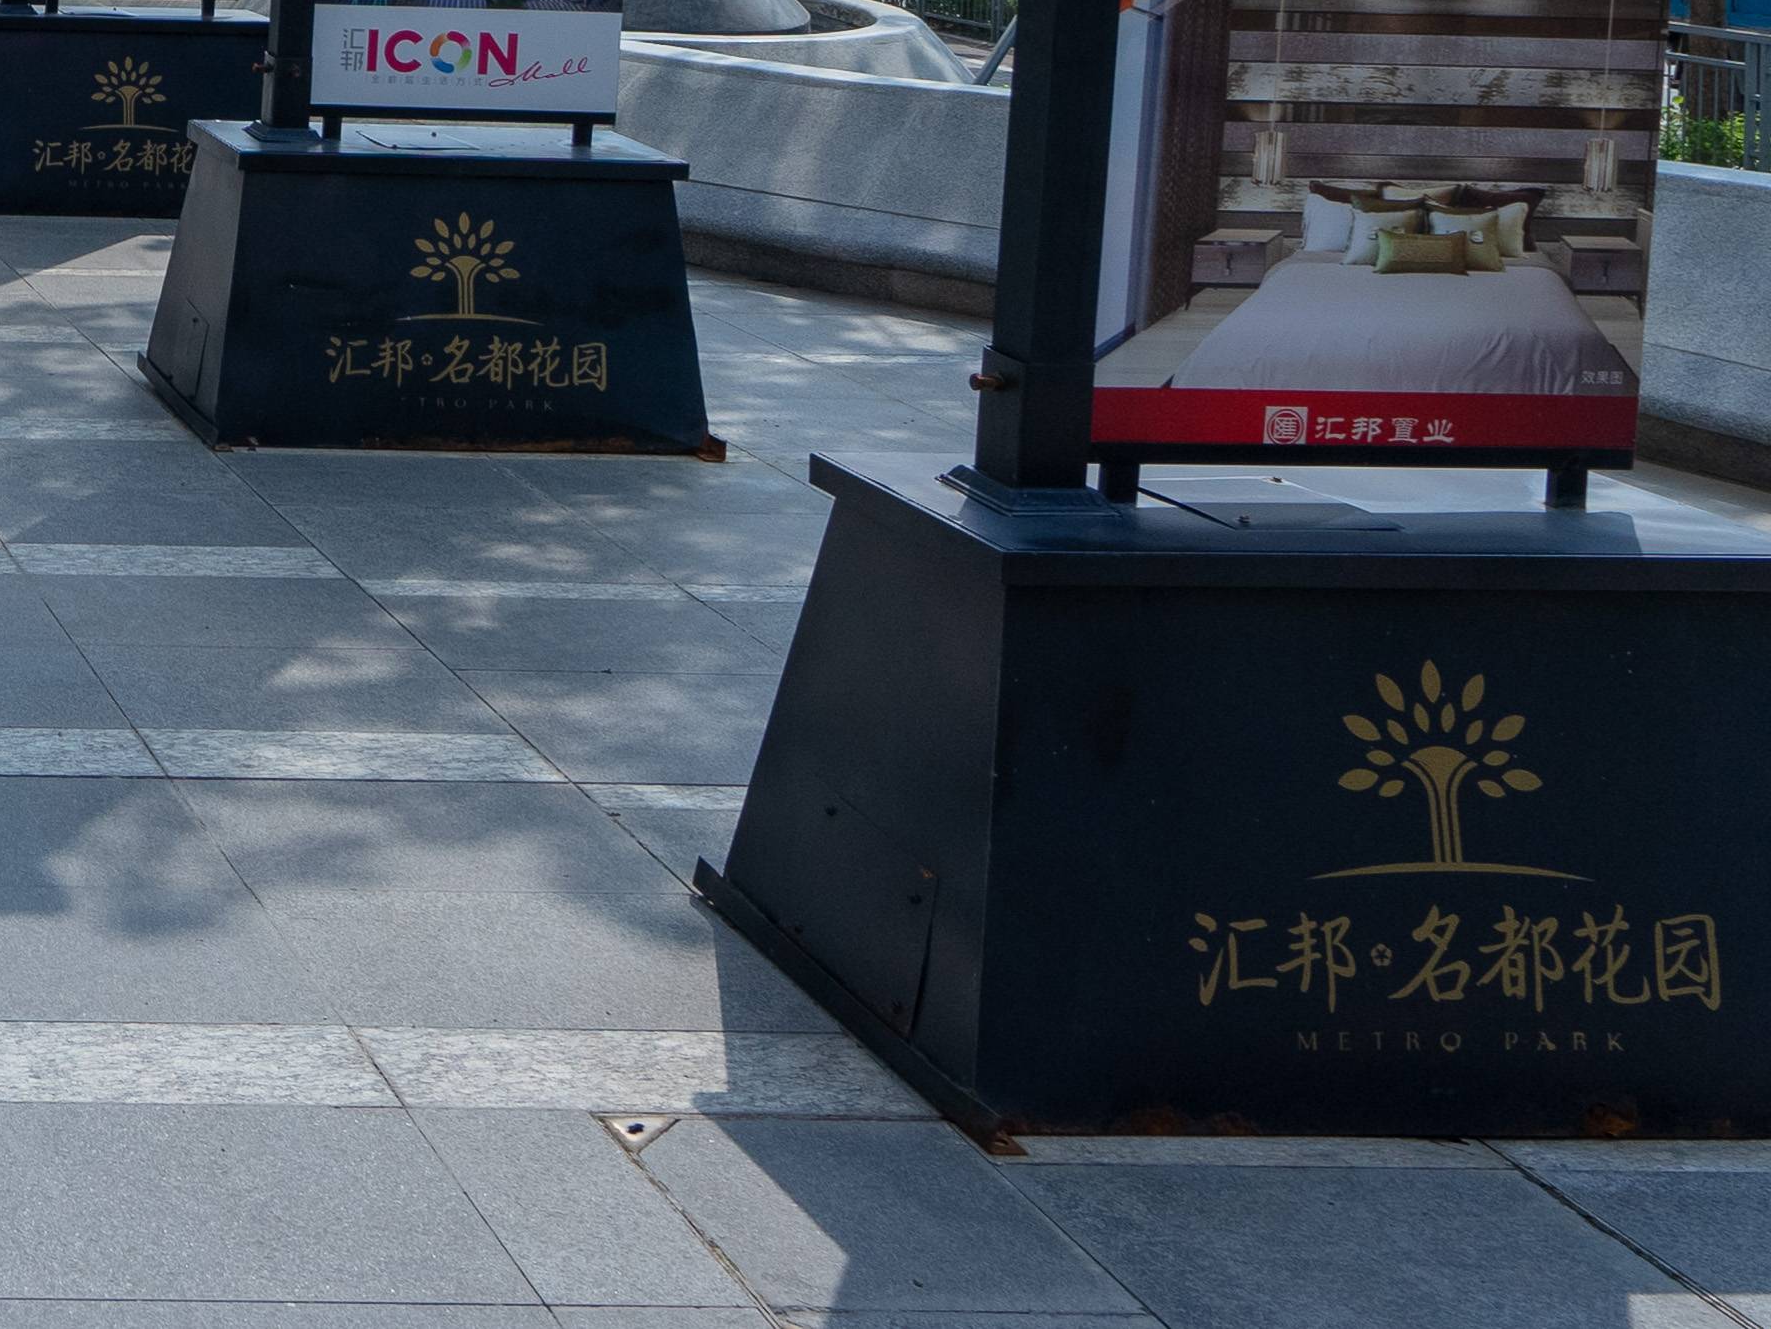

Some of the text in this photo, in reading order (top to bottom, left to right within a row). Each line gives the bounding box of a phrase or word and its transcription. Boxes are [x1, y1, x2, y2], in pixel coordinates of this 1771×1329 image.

[366, 28, 519, 77] ICON
[1580, 370, 1623, 386] 效果图
[1314, 416, 1455, 444] 汇邦置业
[1297, 1031, 1626, 1052] METRO PARK
